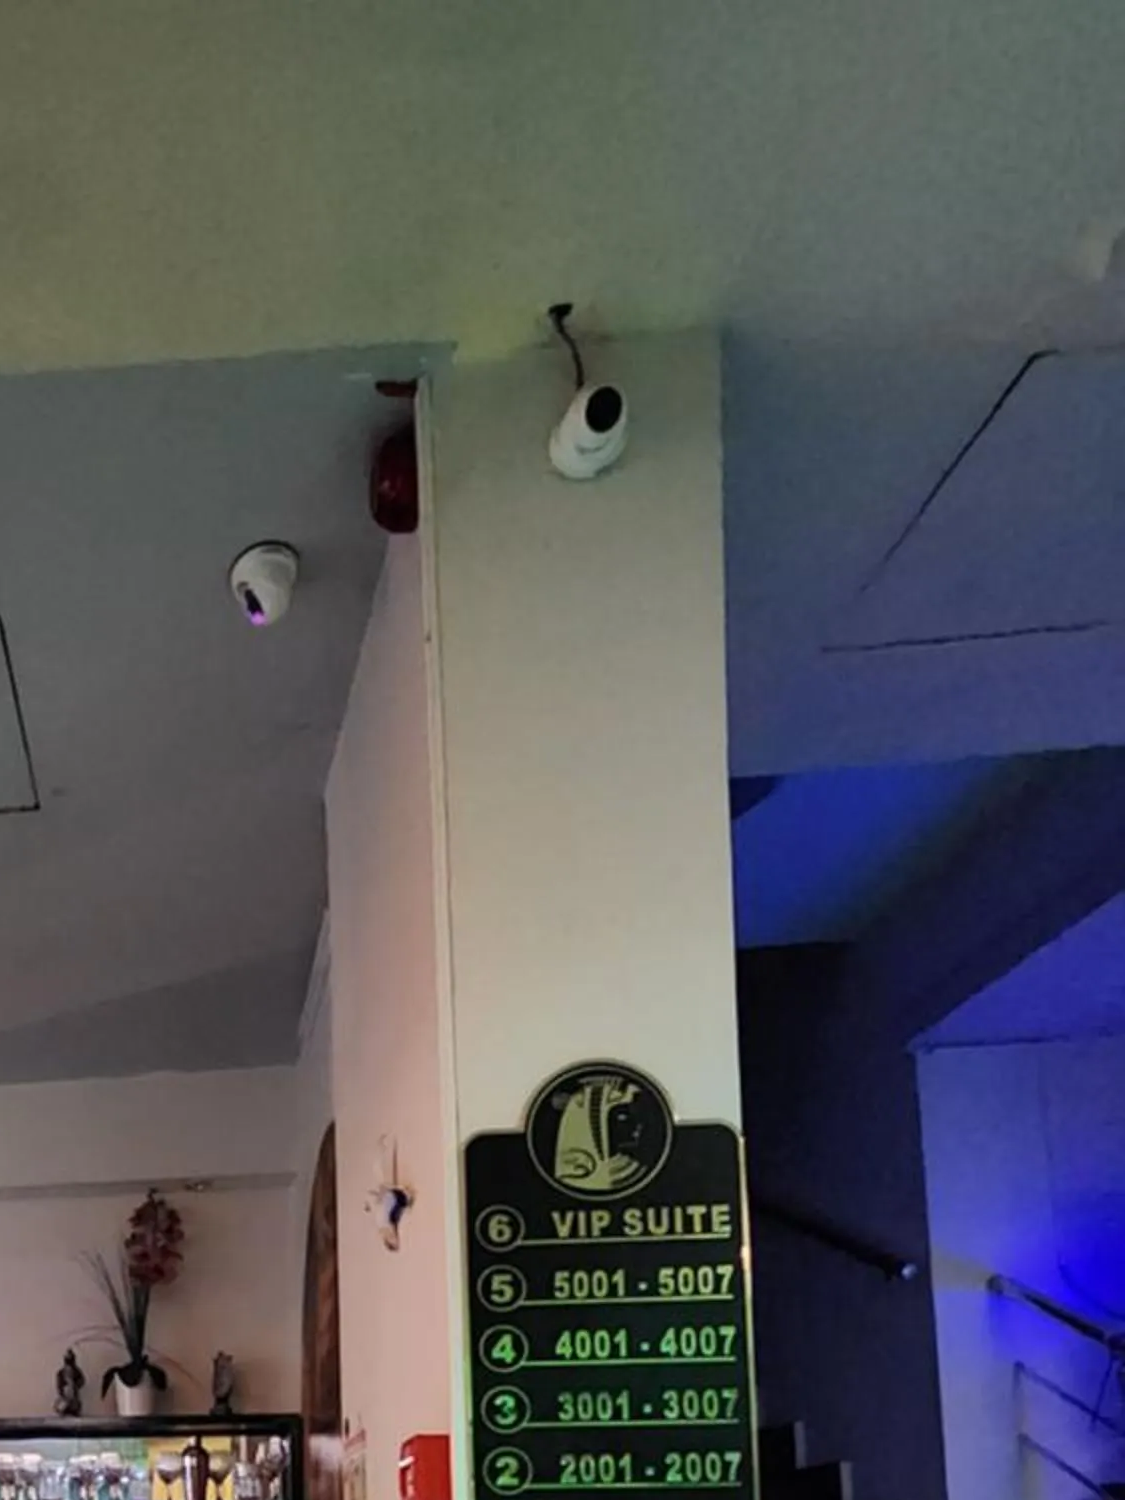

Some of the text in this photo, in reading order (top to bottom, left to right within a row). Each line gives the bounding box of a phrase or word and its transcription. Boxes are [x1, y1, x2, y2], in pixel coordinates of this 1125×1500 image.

[487, 1204, 732, 1242] 6 VIP SUITE
[490, 1274, 514, 1303] 5
[554, 1269, 625, 1299] 5001
[658, 1265, 734, 1296] 5007
[491, 1334, 516, 1363] 4
[555, 1329, 627, 1359] 4001
[660, 1326, 737, 1357] 4007
[493, 1395, 517, 1425] 3
[558, 1391, 630, 1421] 3001
[662, 1388, 739, 1419] 3007
[495, 1456, 520, 1486] 2
[560, 1452, 633, 1483] 2001
[664, 1452, 743, 1483] 2007
